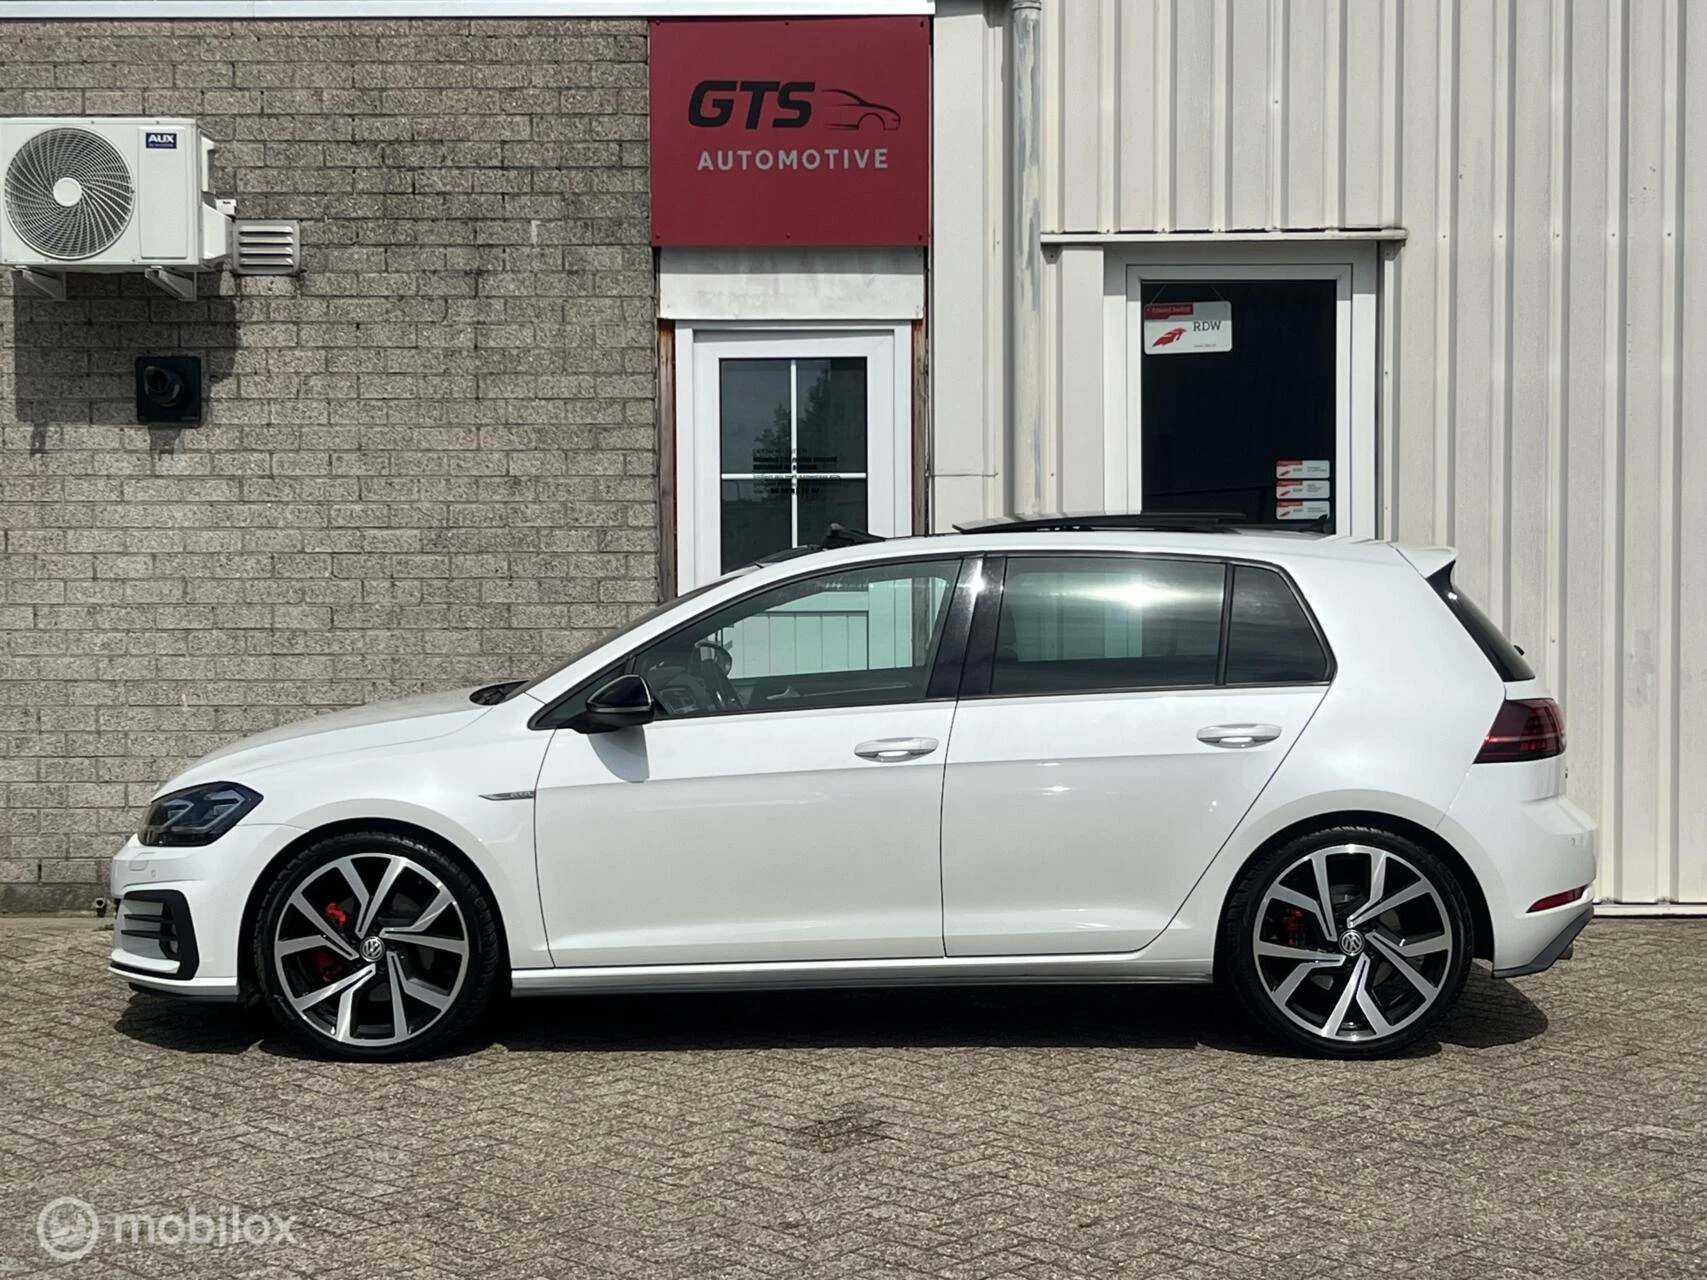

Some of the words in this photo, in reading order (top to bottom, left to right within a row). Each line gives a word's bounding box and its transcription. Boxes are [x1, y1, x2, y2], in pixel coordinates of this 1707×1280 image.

[688, 80, 816, 130] GTS
[148, 134, 175, 143] AUX
[697, 148, 889, 171] AUTOMOTIVE
[1193, 320, 1222, 332] RDW
